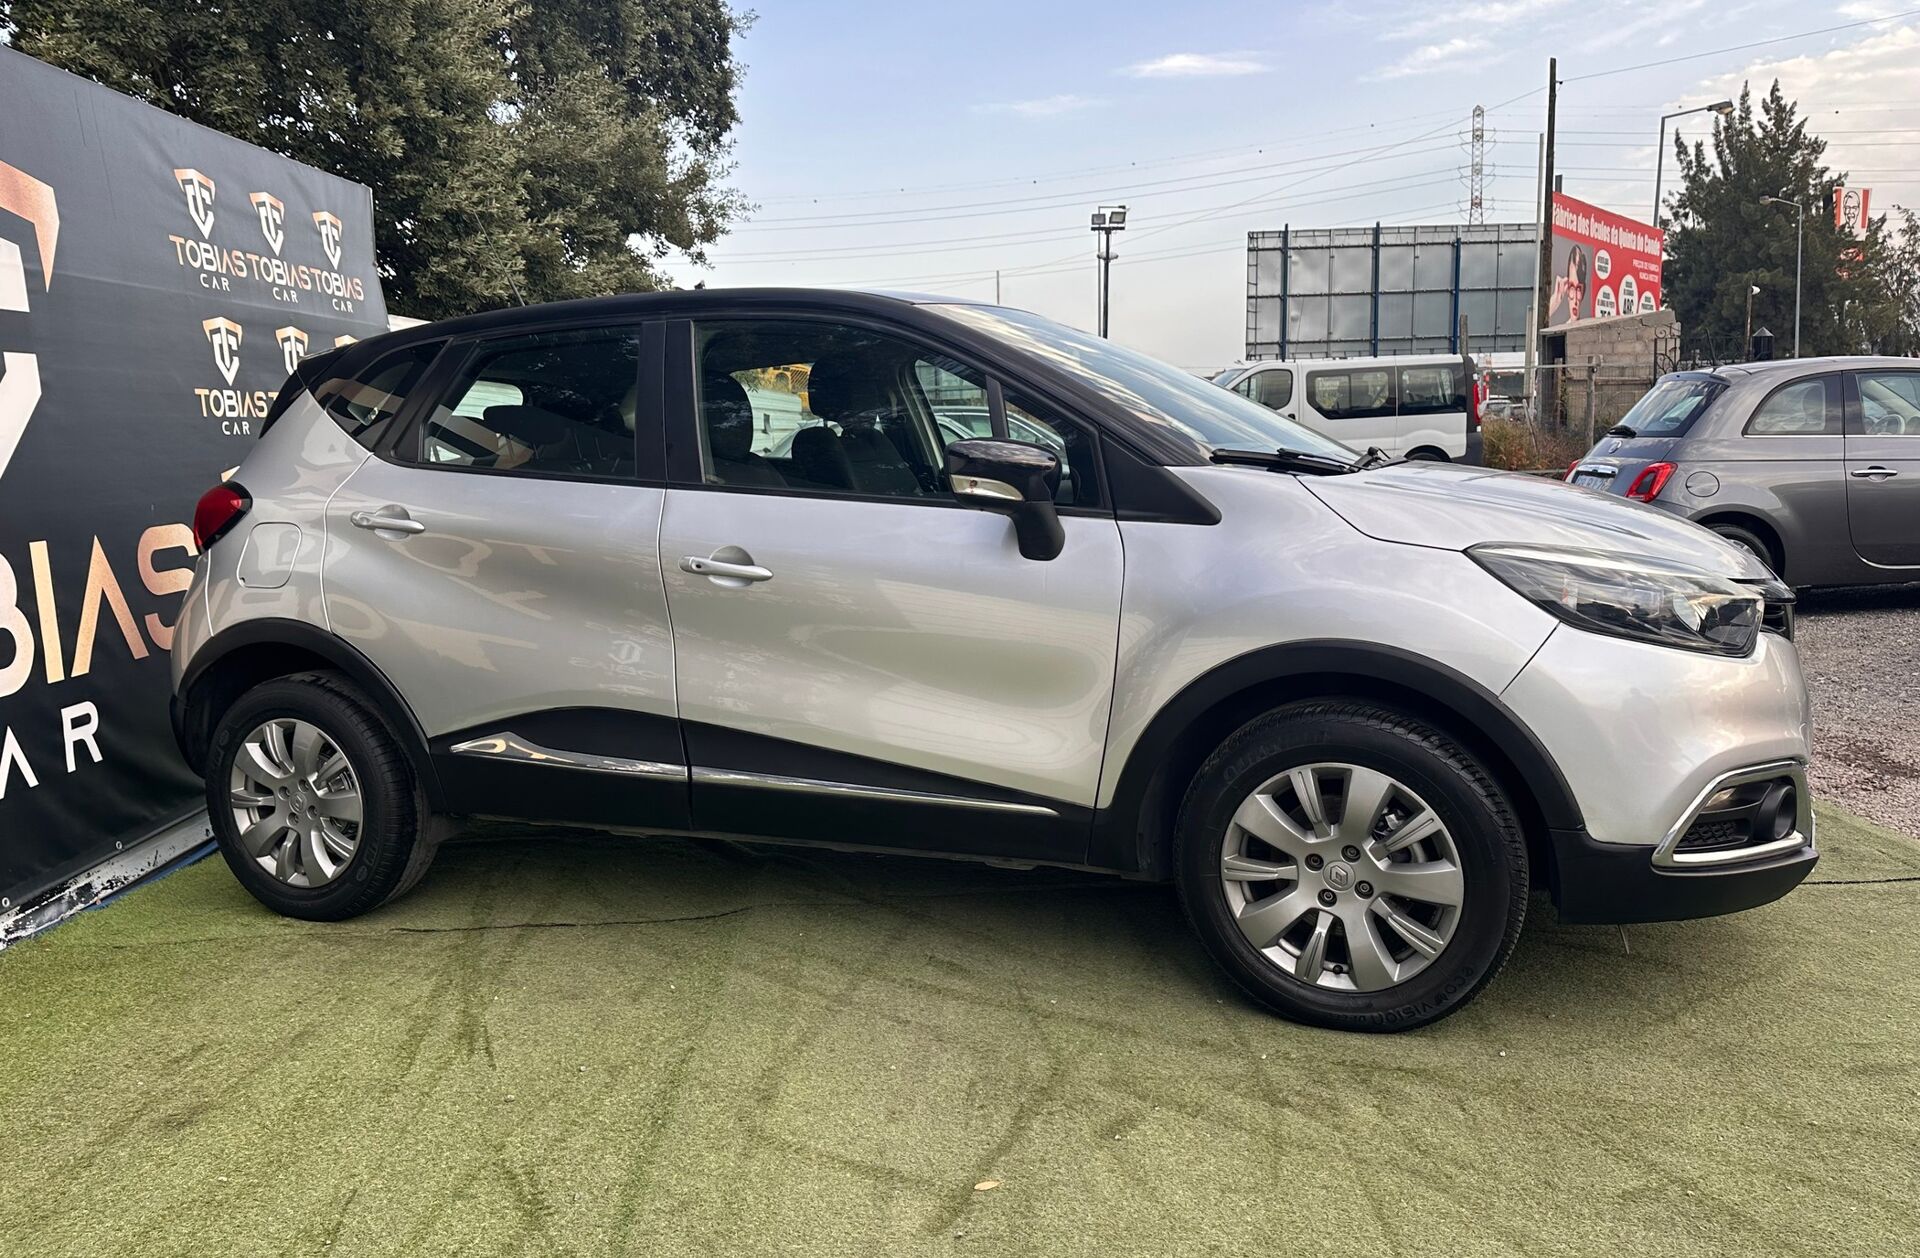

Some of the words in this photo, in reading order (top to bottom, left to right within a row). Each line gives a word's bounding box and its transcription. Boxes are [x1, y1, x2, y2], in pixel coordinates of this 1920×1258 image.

[1578, 212, 1590, 237] dos
[1590, 213, 1610, 244] Óculos
[1611, 224, 1618, 245] da
[1619, 226, 1637, 250] Quinta
[1637, 231, 1644, 252] do
[1644, 234, 1660, 256] Conde
[168, 234, 248, 278] TOBIAS
[246, 252, 312, 290] TOBIAS
[200, 273, 231, 292] CAR
[272, 287, 299, 304] CAR
[310, 267, 364, 300] TOBIAS
[332, 298, 354, 313] CAR
[194, 388, 268, 418] TOBIAS
[221, 421, 250, 435] CAR
